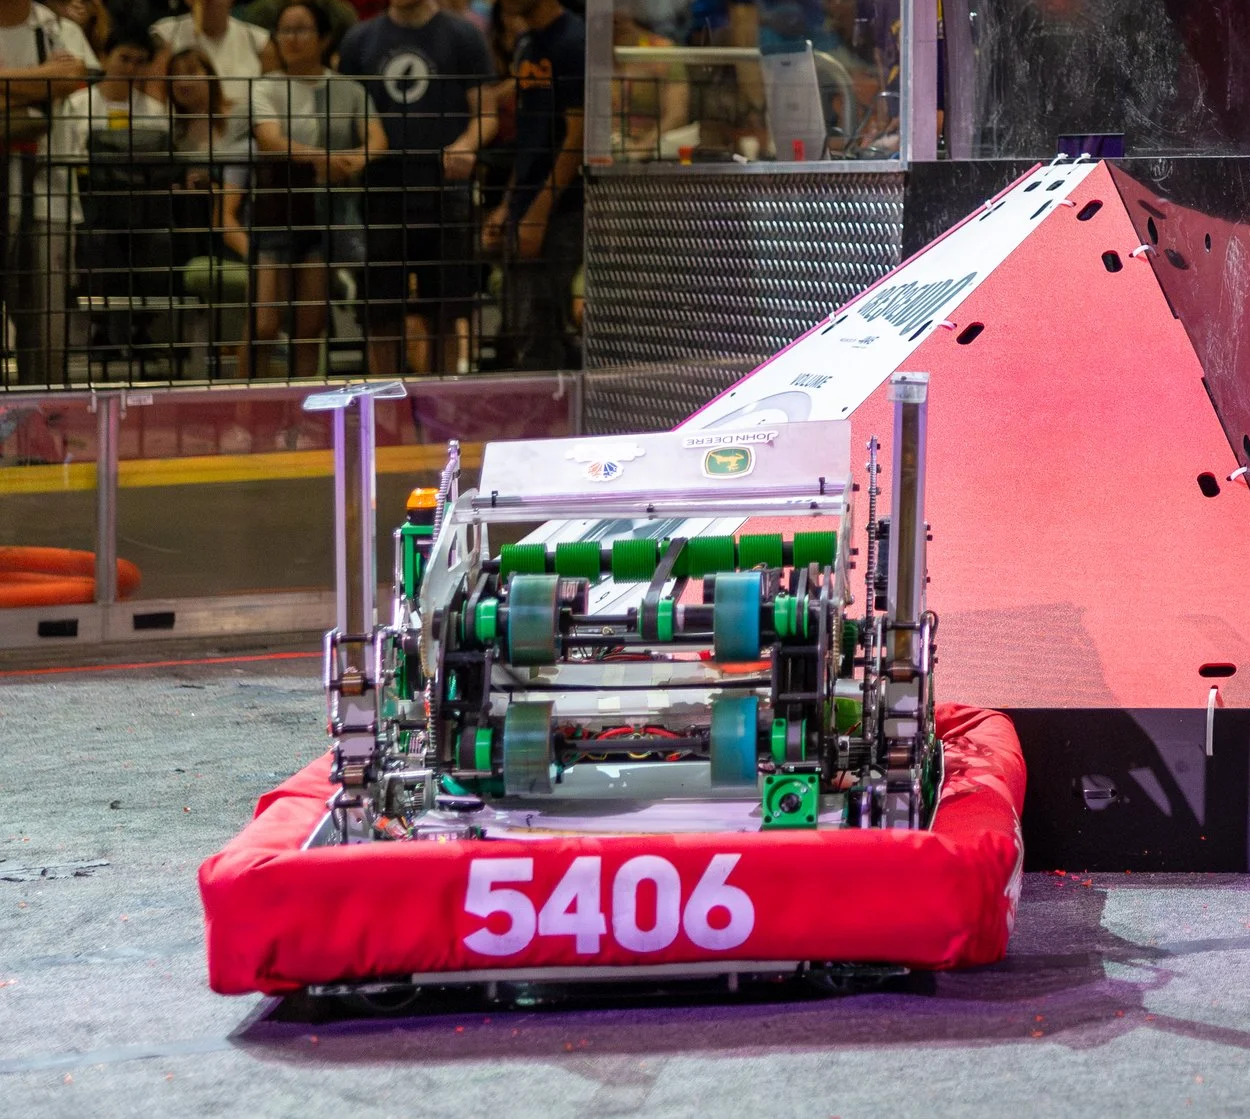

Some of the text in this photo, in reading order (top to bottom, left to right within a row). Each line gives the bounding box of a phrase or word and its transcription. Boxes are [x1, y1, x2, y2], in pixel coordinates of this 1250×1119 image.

[686, 432, 776, 446] JOHN DEERE
[463, 853, 755, 956] 5406
